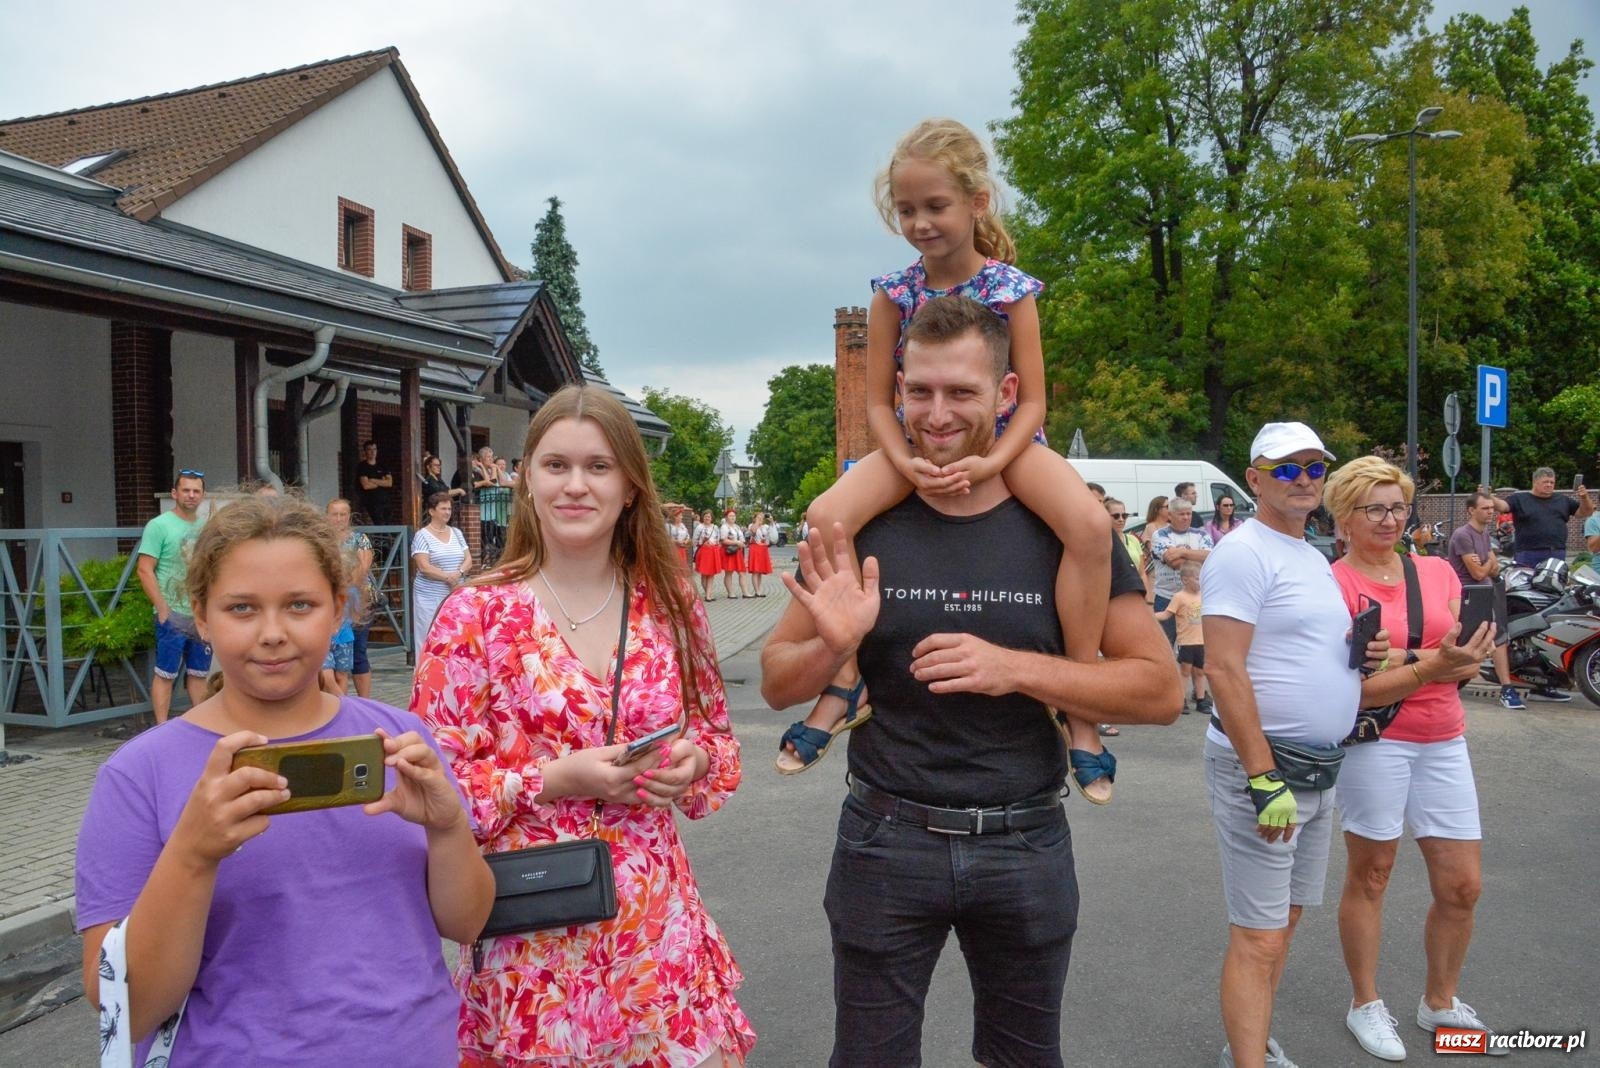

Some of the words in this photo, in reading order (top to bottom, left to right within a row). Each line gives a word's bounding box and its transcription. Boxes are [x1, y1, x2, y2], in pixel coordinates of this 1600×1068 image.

[1485, 373, 1501, 418] P
[884, 588, 948, 601] TOMMY
[972, 590, 1043, 605] HILFIGER
[944, 604, 961, 612] EST.
[963, 604, 982, 612] 1985
